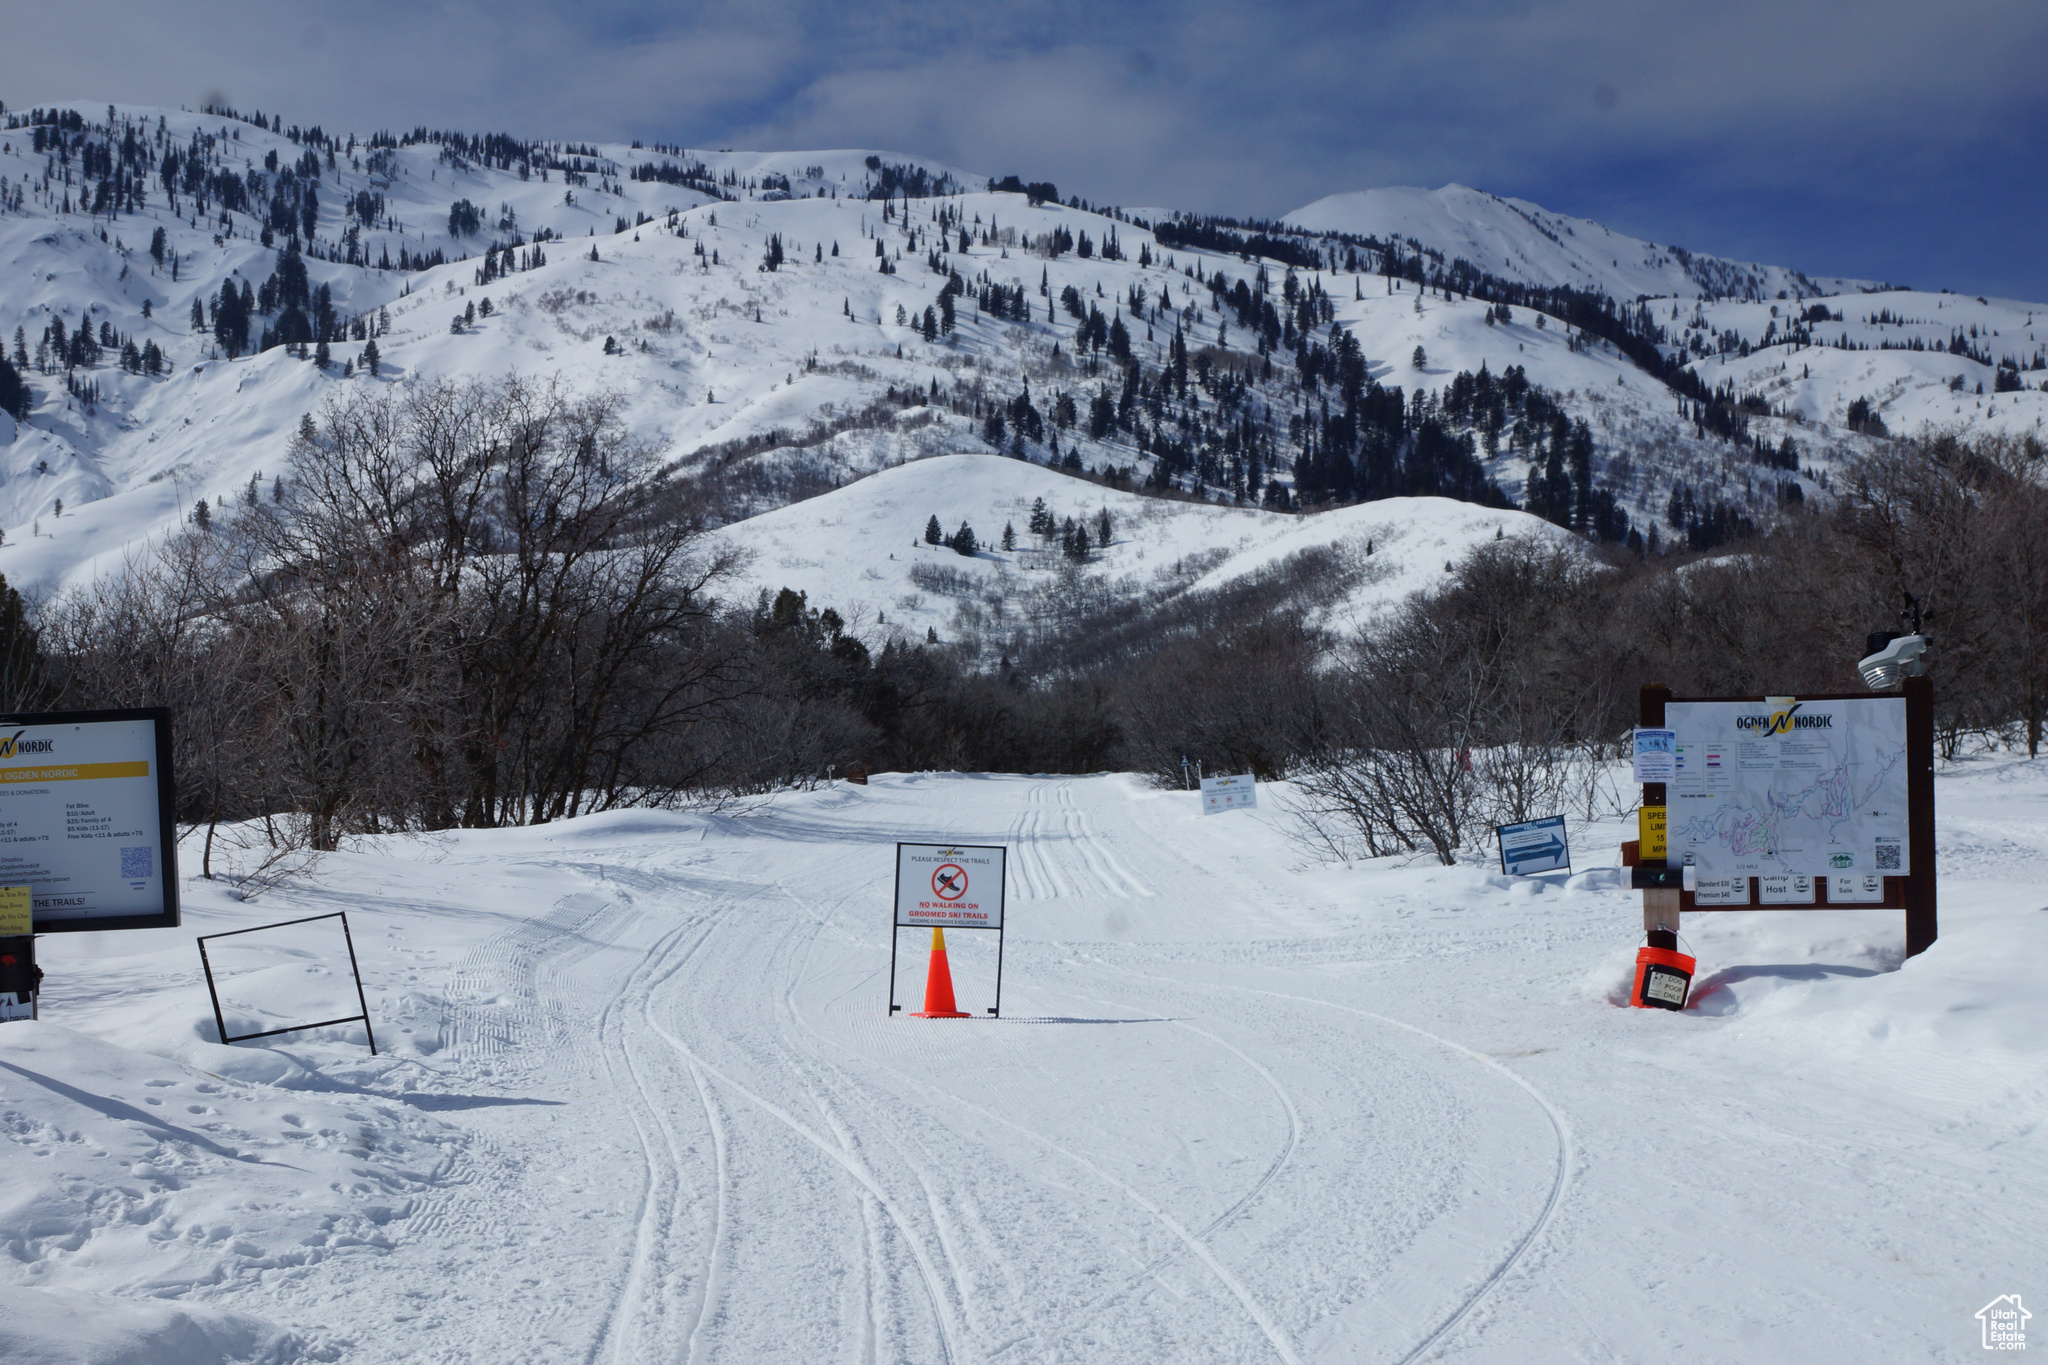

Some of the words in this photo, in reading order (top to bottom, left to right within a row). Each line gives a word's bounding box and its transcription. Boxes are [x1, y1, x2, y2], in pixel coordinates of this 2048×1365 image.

[1736, 716, 1770, 729] OGDEN
[1794, 715, 1833, 729] NORDIC
[18, 740, 54, 754] NORDIC
[4, 771, 38, 780] OGDEN
[41, 768, 79, 778] NORDIC
[1647, 812, 1666, 820] SPEE
[34, 899, 50, 908] THE
[52, 897, 86, 907] TRAILS!
[1668, 976, 1682, 984] DOG
[1664, 984, 1682, 993] POOP
[1664, 992, 1680, 1000] ONLY
